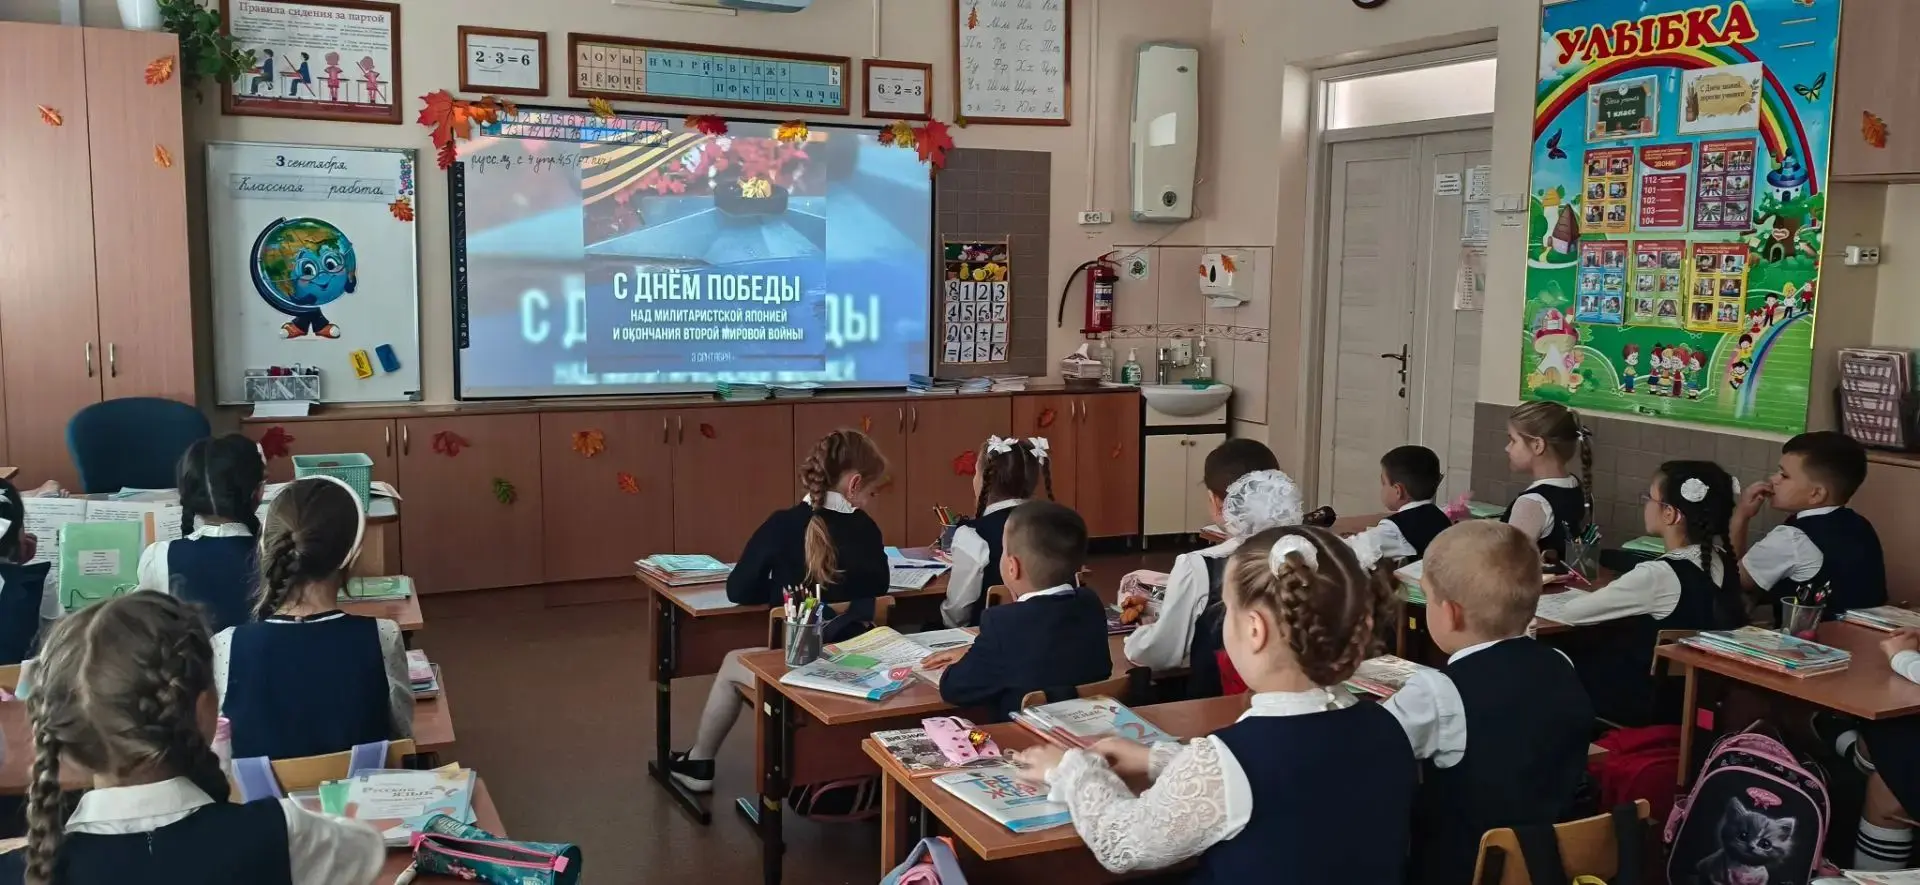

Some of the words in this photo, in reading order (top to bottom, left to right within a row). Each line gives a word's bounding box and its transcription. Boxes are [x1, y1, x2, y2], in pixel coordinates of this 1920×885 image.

[239, 1, 286, 15] Правила
[288, 7, 332, 19] сидения
[335, 11, 345, 20] за
[349, 12, 385, 23] партой
[1556, 3, 1757, 64] УЛЫБКА
[1613, 109, 1636, 118] класс
[276, 155, 285, 167] 3
[238, 177, 305, 192] Классная
[1644, 176, 1657, 184] 112
[1642, 217, 1654, 225] 104
[613, 272, 628, 300] С
[634, 268, 700, 303] ДНЁМ
[708, 273, 800, 304] ПОБЕДЫ
[964, 284, 970, 300] 1
[980, 284, 988, 300] 2
[997, 284, 1005, 300] 3
[630, 309, 652, 323] НАД
[654, 307, 743, 322] МИЛИТАРИСТСКОЙ
[745, 309, 787, 323] ЯПОНИЕЙ
[949, 305, 956, 317] 4
[613, 327, 620, 340] И
[622, 327, 681, 341] ОКОНЧАНИЯ
[683, 326, 719, 340] ВТОРОЙ
[721, 326, 765, 340] МИРОВОЙ
